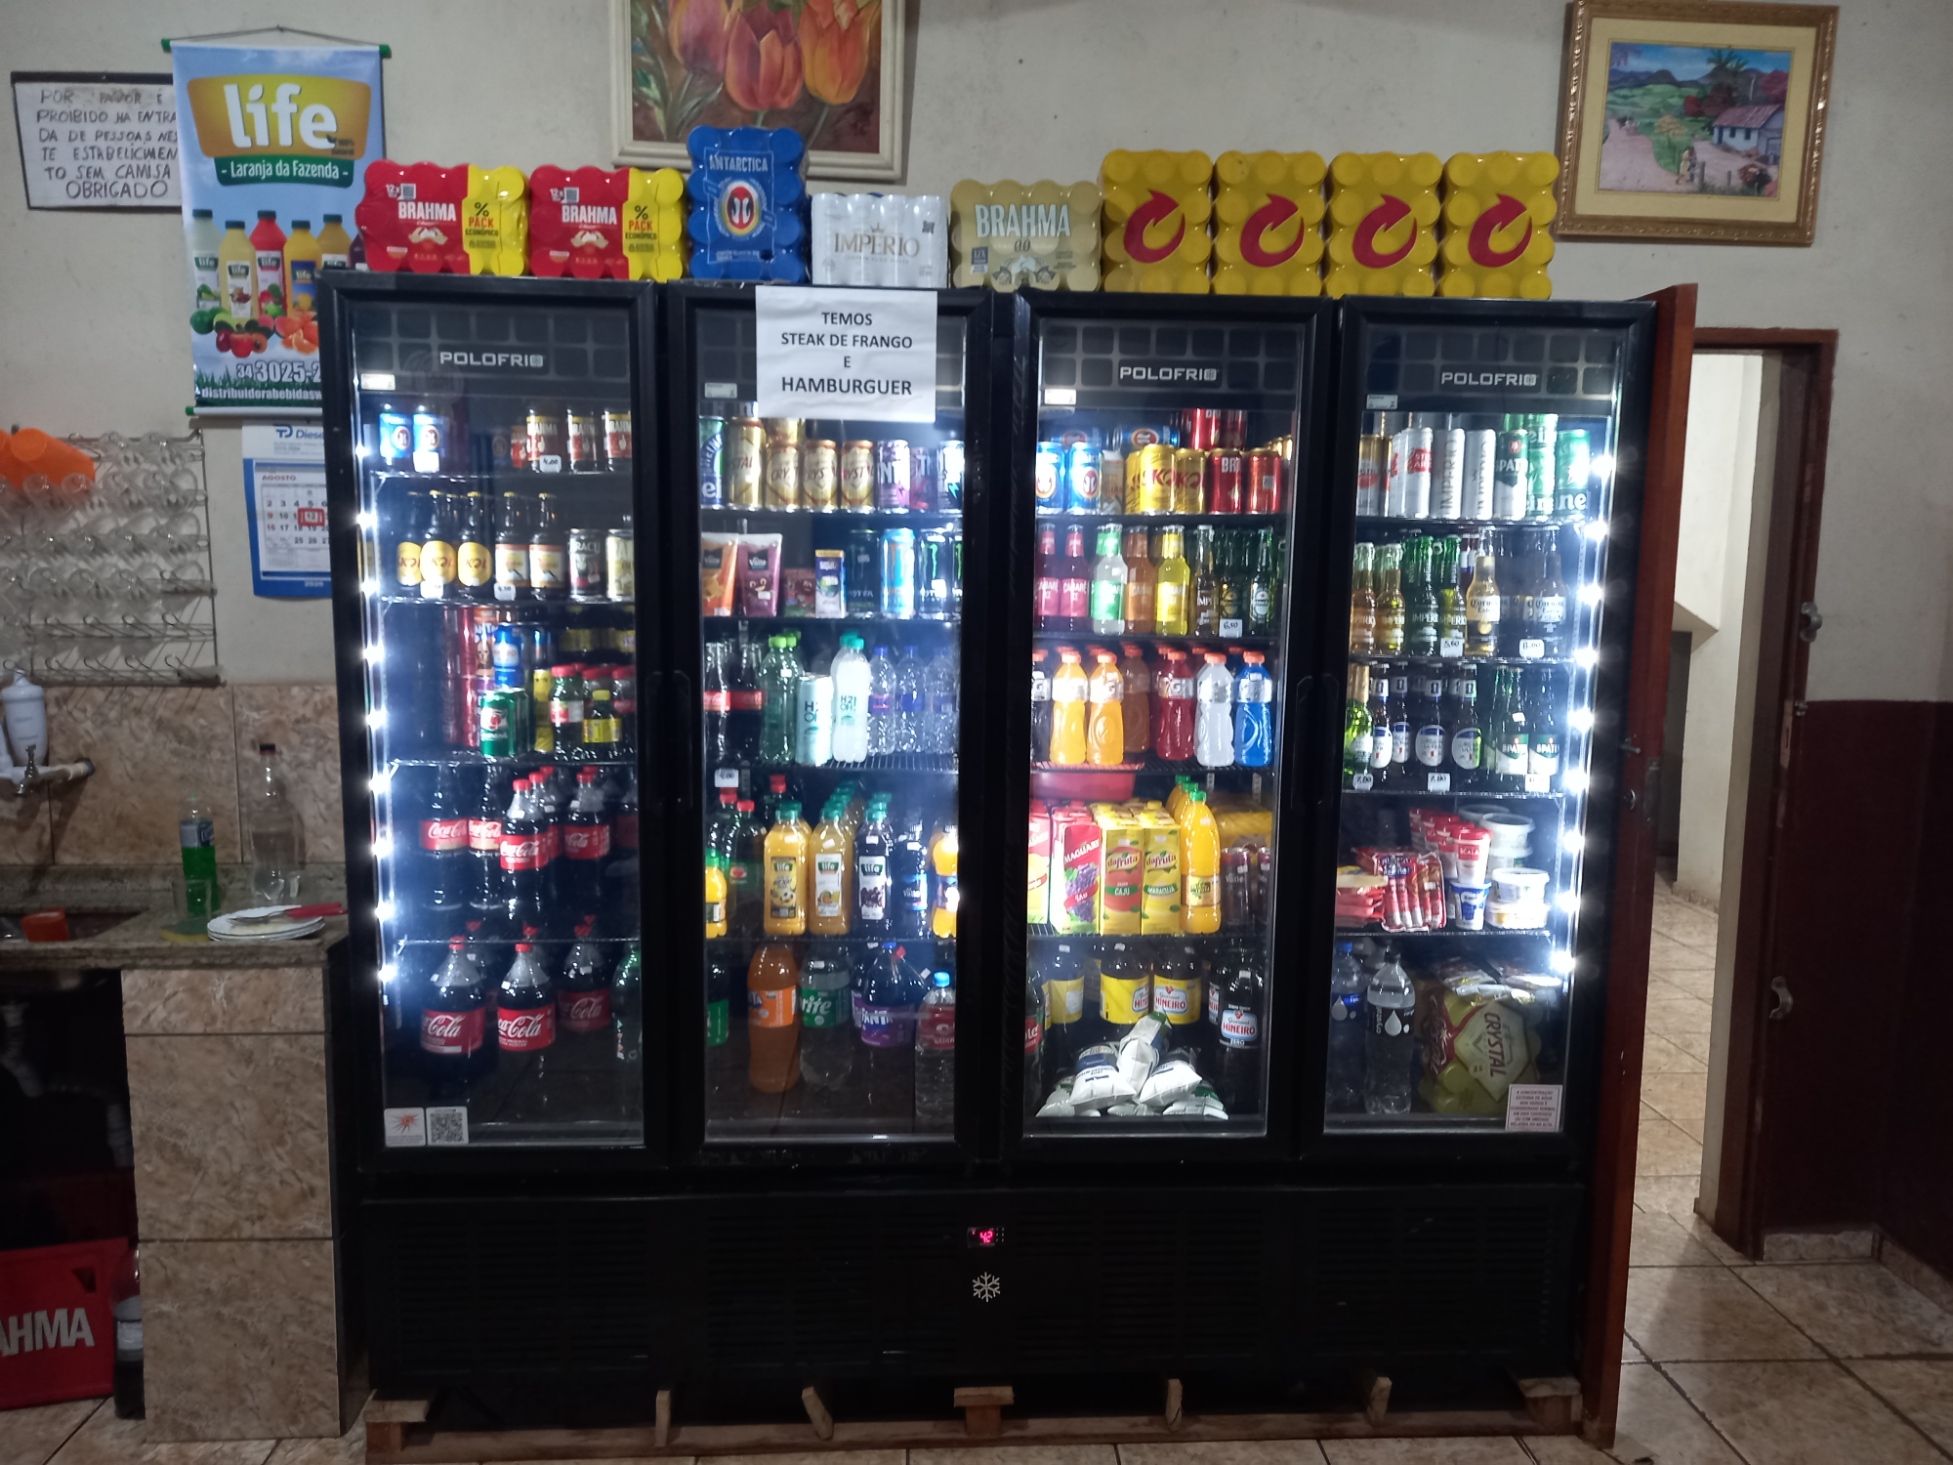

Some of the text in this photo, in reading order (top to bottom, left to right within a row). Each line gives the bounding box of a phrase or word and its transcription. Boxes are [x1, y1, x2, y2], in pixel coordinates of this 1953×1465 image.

[41, 89, 74, 104] POR
[37, 109, 108, 123] PROIBIDO
[223, 83, 338, 150] life
[39, 128, 58, 143] DA
[68, 130, 86, 142] DE
[95, 130, 152, 144] PESSOAS
[42, 147, 56, 161] TE
[230, 160, 340, 180] Laranja da Fazenda
[709, 155, 768, 172] ANTARCTICA
[44, 164, 171, 180] TO SEM CAMISA
[66, 180, 168, 199] OBRIGADO
[398, 201, 456, 221] BRAHMA
[474, 202, 489, 217] %
[562, 205, 617, 225] BRAHMA
[634, 205, 648, 219] %
[469, 217, 494, 228] PACK
[629, 220, 653, 231] PACK
[974, 203, 1071, 238] BRAHMA
[821, 311, 873, 326] TEMOS
[781, 332, 913, 349] STEAK DE FRANGO
[844, 356, 852, 368] E
[236, 364, 253, 378] 34
[781, 376, 912, 396] HAMBURGUER
[776, 863, 790, 871] life
[822, 862, 835, 870] life
[1107, 854, 1139, 868] dafruta
[1145, 853, 1177, 867] dafruta
[864, 864, 880, 873] life
[1114, 888, 1130, 896] CAJU
[1155, 998, 1186, 1010] MINEIRO
[1223, 1022, 1256, 1034] MINEIRO
[1484, 1012, 1507, 1077] CRYSTAL
